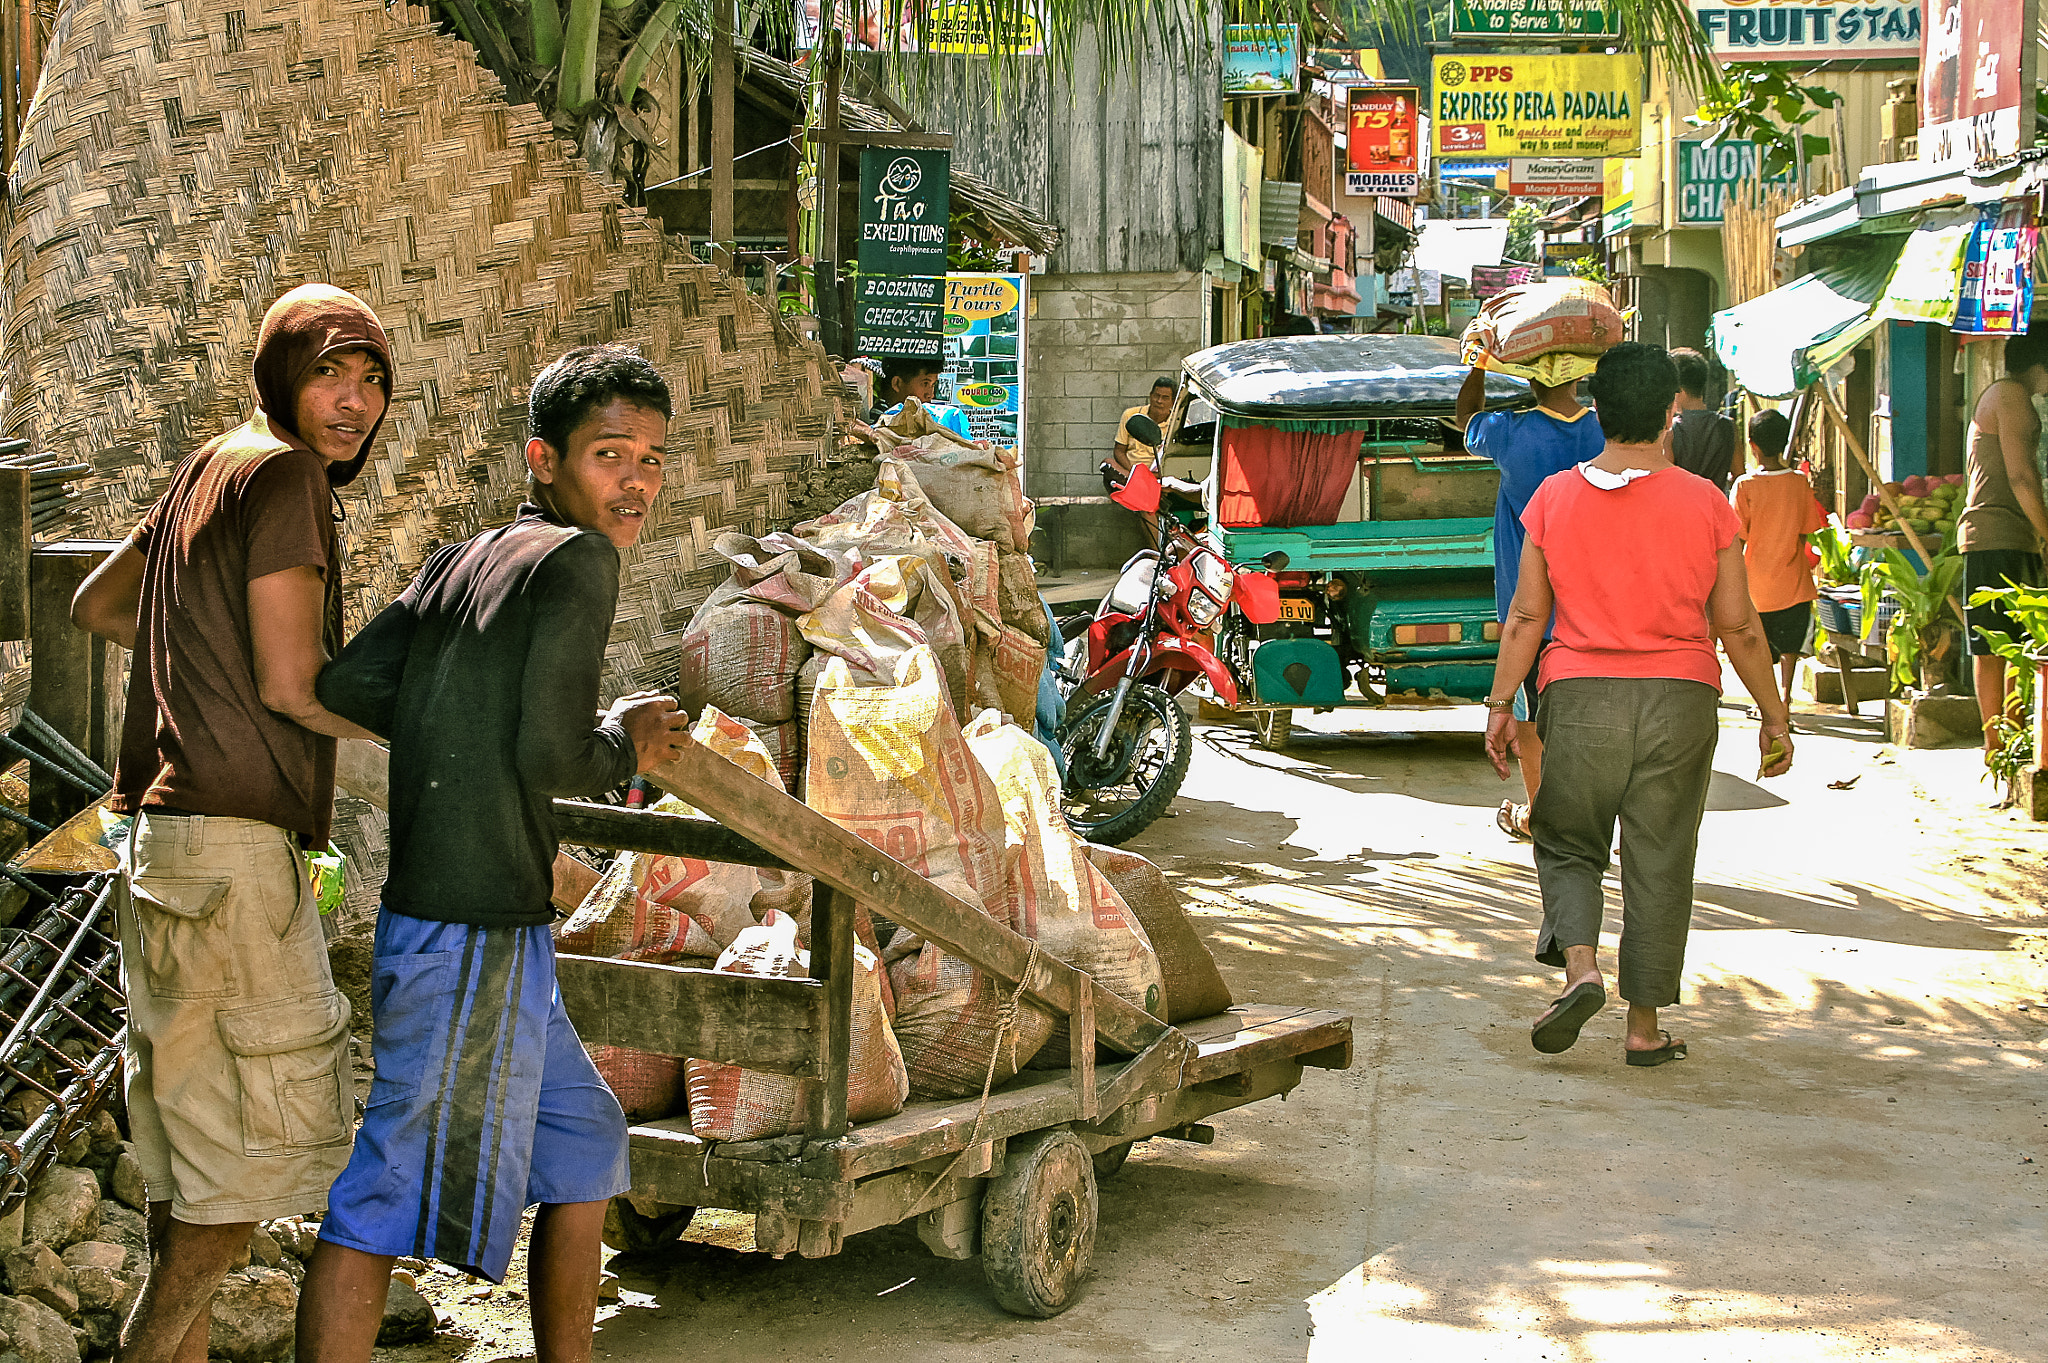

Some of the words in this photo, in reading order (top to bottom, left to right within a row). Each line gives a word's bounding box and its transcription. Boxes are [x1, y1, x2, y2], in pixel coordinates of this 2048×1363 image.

[1489, 13, 1504, 29] to
[1510, 12, 1549, 29] Serve
[1697, 8, 1835, 46] FRUIT
[1470, 66, 1513, 82] PPS
[1351, 103, 1393, 111] TANDUAY
[1440, 91, 1508, 121] EXPRESS
[1513, 91, 1557, 121] PERA
[1563, 90, 1631, 121] PADALA
[1353, 111, 1390, 128] T5
[1451, 126, 1483, 142] 3%
[1497, 124, 1514, 138] The
[1517, 125, 1563, 139] quickest
[1566, 124, 1582, 137] and
[1585, 125, 1633, 140] cheapest
[1520, 140, 1538, 152] way
[1540, 139, 1549, 150] to
[1553, 138, 1573, 150] send
[1576, 139, 1609, 152] money!
[1527, 163, 1595, 175] MoneyGram
[1349, 174, 1415, 186] MORALES
[1525, 184, 1557, 195] Money
[1560, 184, 1597, 194] Transfer
[874, 192, 926, 221] Tao
[863, 223, 945, 243] EXPEDITIONS
[865, 280, 935, 298] BOOKINGS
[948, 281, 1003, 296] Turtle
[950, 295, 1001, 311] Tours
[864, 307, 937, 328] CHECK-IN
[858, 335, 939, 354] DEPARTURES
[943, 738, 967, 785] APO
